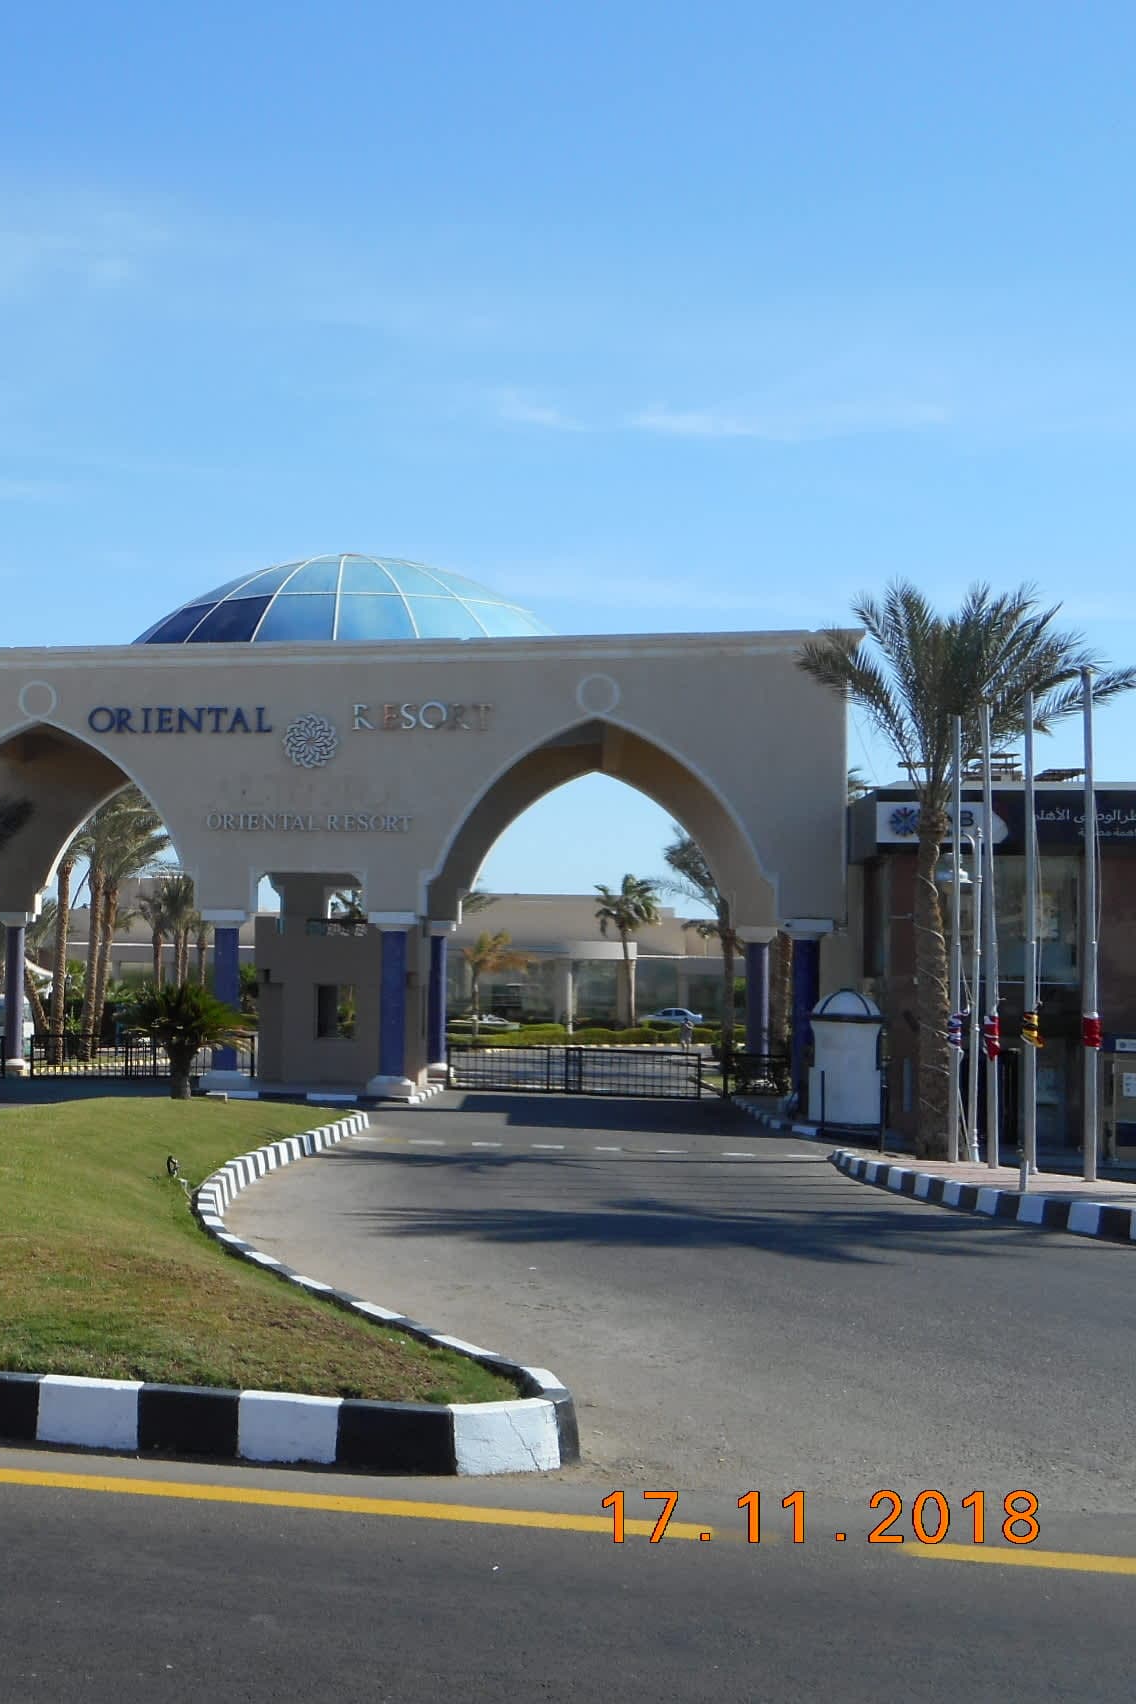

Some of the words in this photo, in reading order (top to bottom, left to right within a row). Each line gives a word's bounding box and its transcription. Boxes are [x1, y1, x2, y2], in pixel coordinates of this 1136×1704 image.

[88, 707, 273, 733] ORIENTAL
[352, 701, 493, 731] RESORT
[206, 812, 320, 831] ORIENTAL
[327, 813, 413, 832] RESORT
